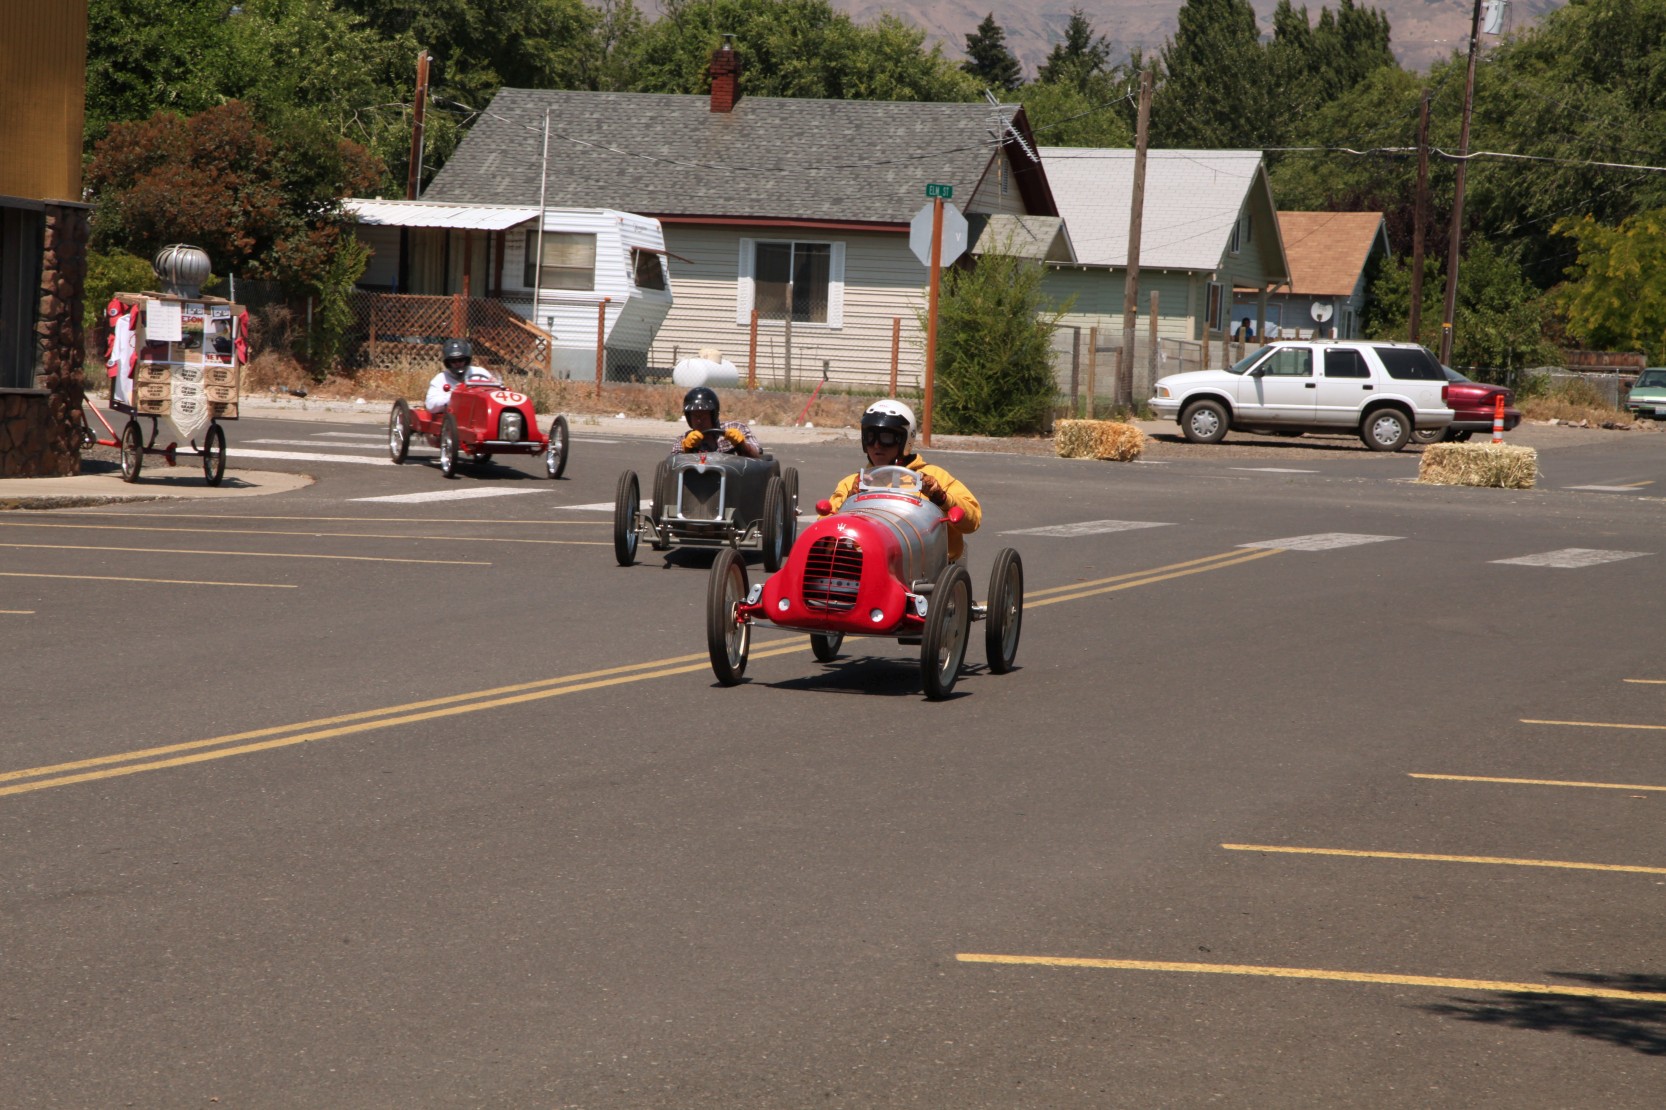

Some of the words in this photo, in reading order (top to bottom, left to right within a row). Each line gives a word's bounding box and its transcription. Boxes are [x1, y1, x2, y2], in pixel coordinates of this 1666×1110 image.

[929, 185, 939, 196] ELM
[942, 187, 949, 197] ST
[495, 391, 522, 402] 46
